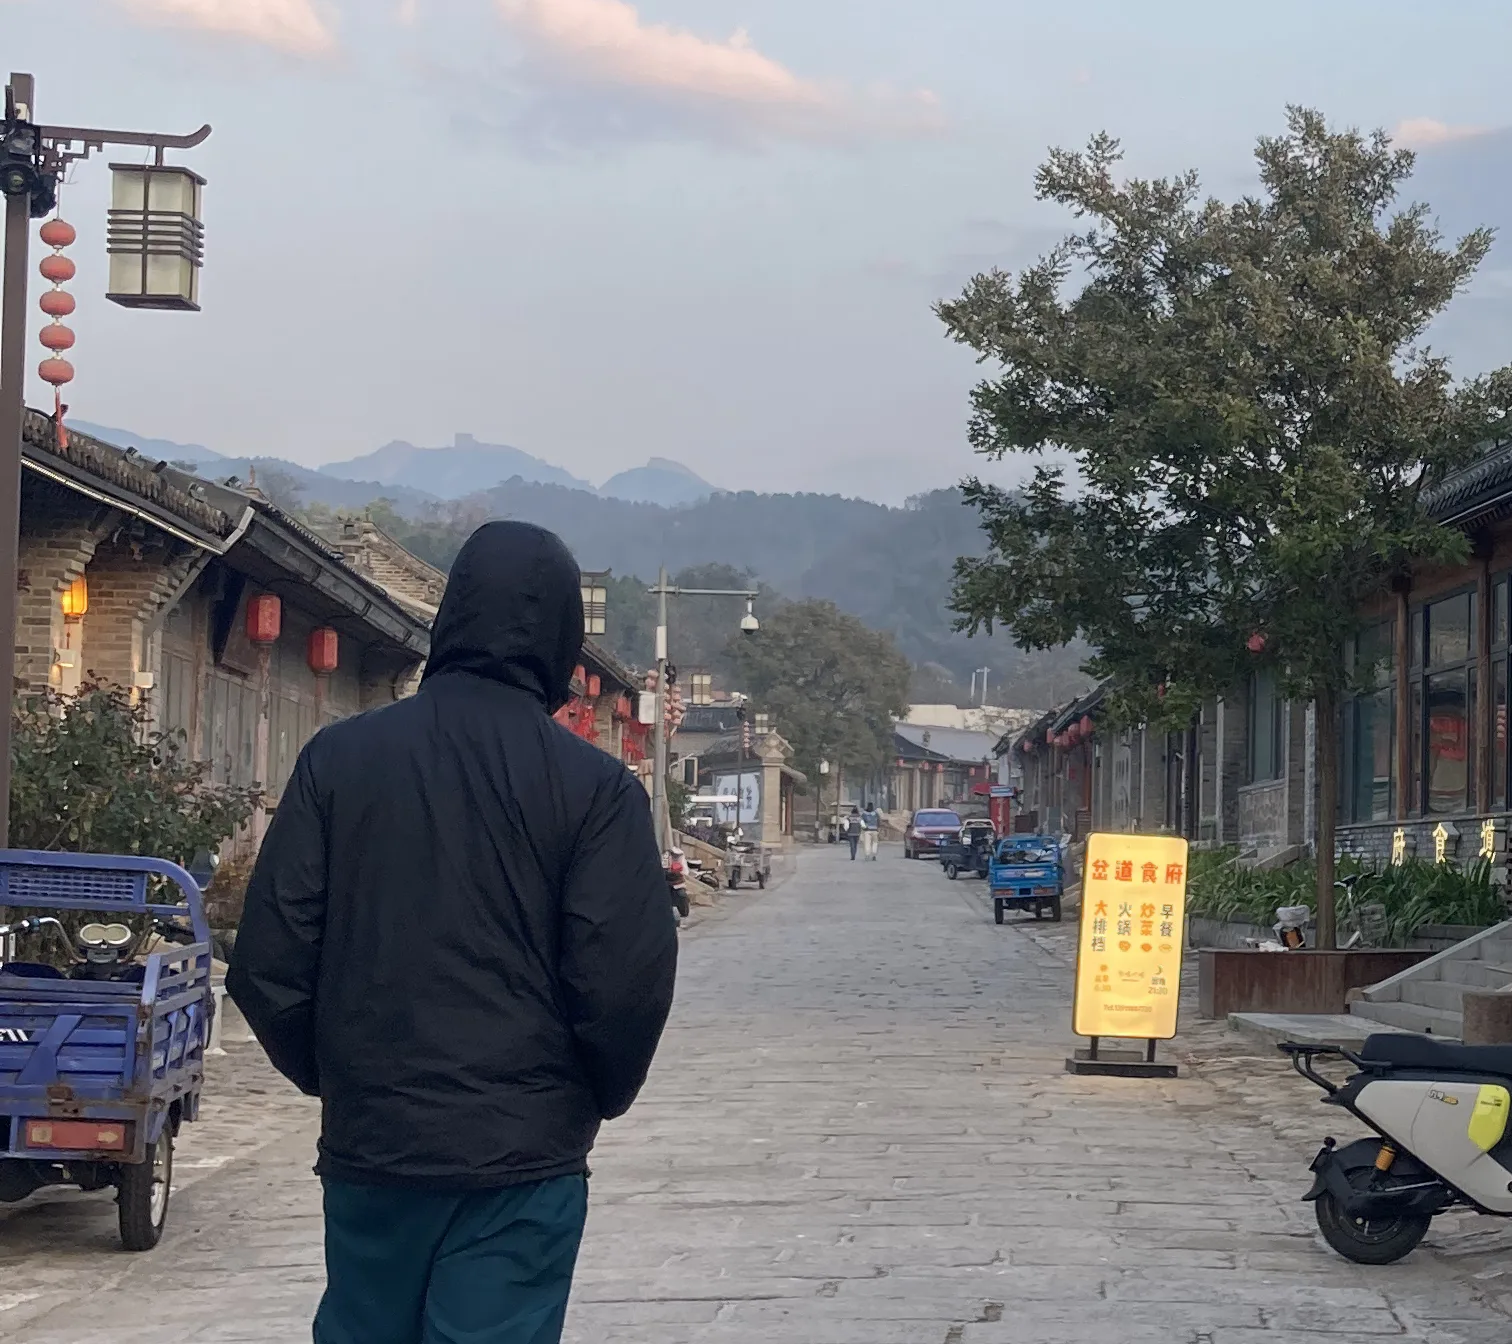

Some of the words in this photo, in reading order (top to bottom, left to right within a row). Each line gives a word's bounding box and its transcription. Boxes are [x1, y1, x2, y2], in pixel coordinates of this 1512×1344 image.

[1091, 859, 1184, 885] 岔道食府
[1091, 900, 1108, 952] 大排档
[1117, 902, 1132, 936] 火锅
[1140, 903, 1156, 937] 炒菜
[1160, 904, 1174, 937] 早餐
